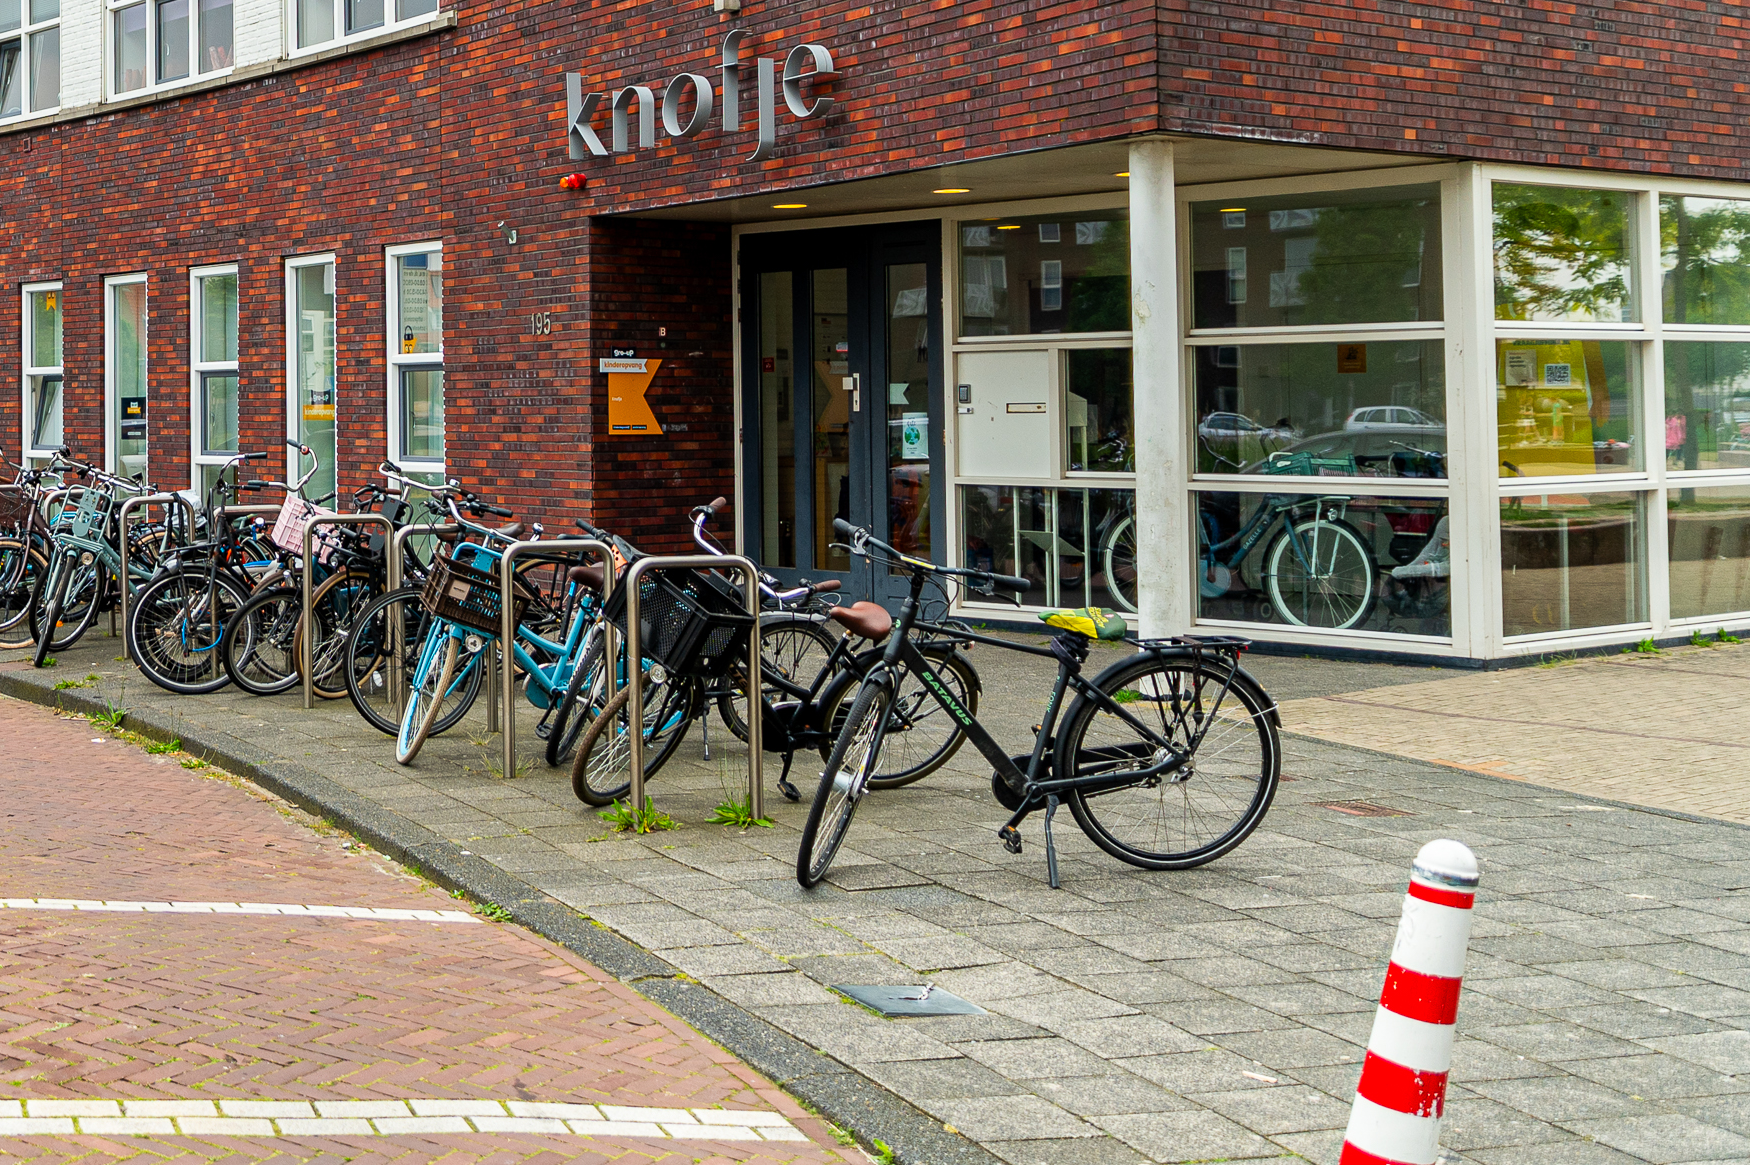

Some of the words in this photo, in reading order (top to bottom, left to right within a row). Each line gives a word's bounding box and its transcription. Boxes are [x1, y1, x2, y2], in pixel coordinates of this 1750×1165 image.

[566, 29, 842, 161] knofje
[531, 311, 551, 336] 195
[604, 361, 643, 370] kinderopvang
[921, 671, 973, 726] BATAVUS
